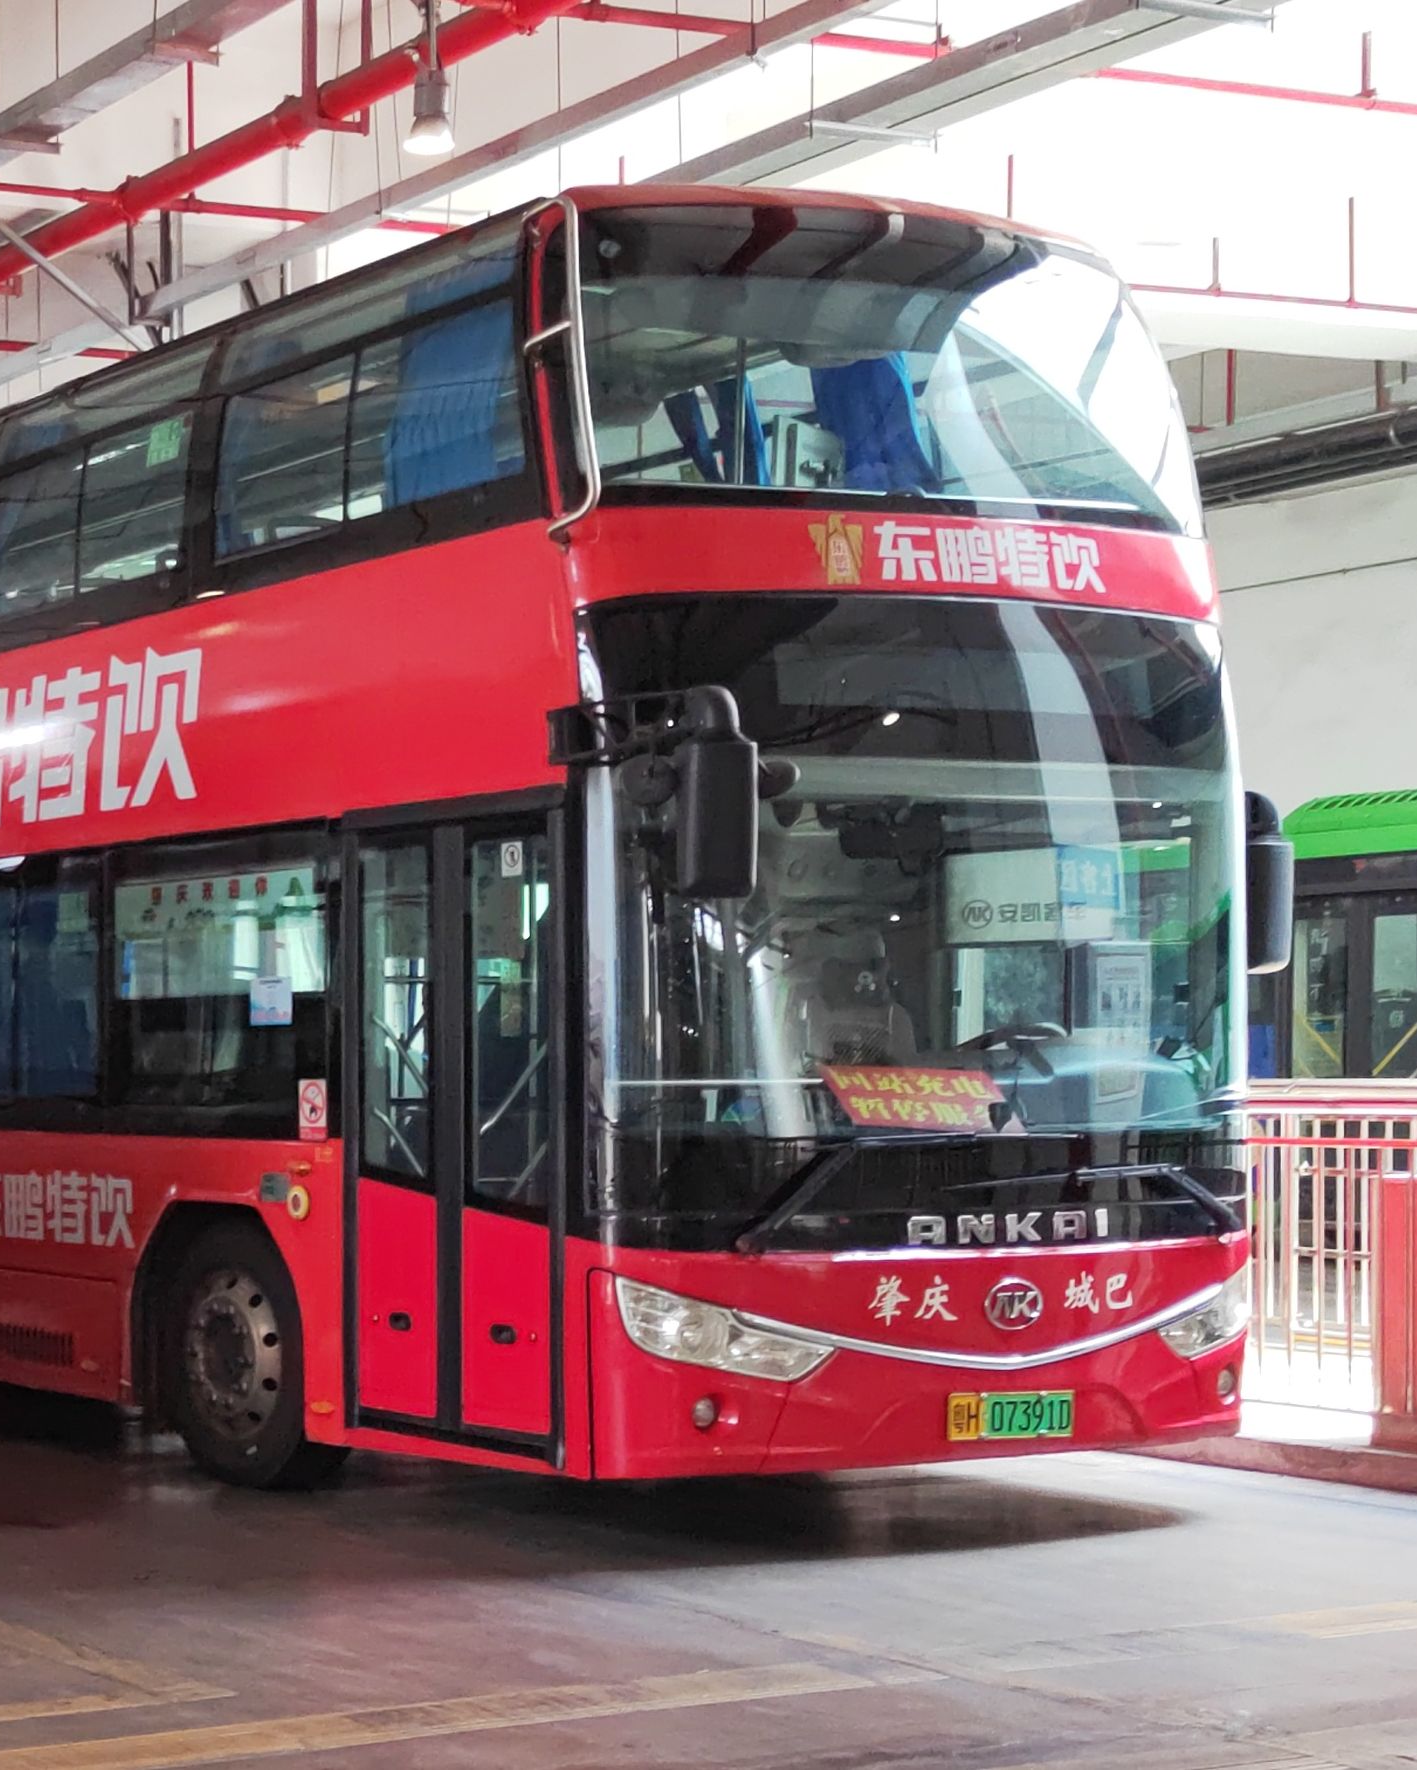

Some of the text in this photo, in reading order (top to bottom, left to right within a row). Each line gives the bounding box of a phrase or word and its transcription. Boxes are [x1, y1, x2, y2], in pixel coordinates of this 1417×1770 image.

[873, 521, 1106, 593] 东鹏特饮
[907, 1207, 1110, 1246] ANKAI
[868, 1274, 958, 1327] 肇庆
[1064, 1270, 1133, 1314] 城巴
